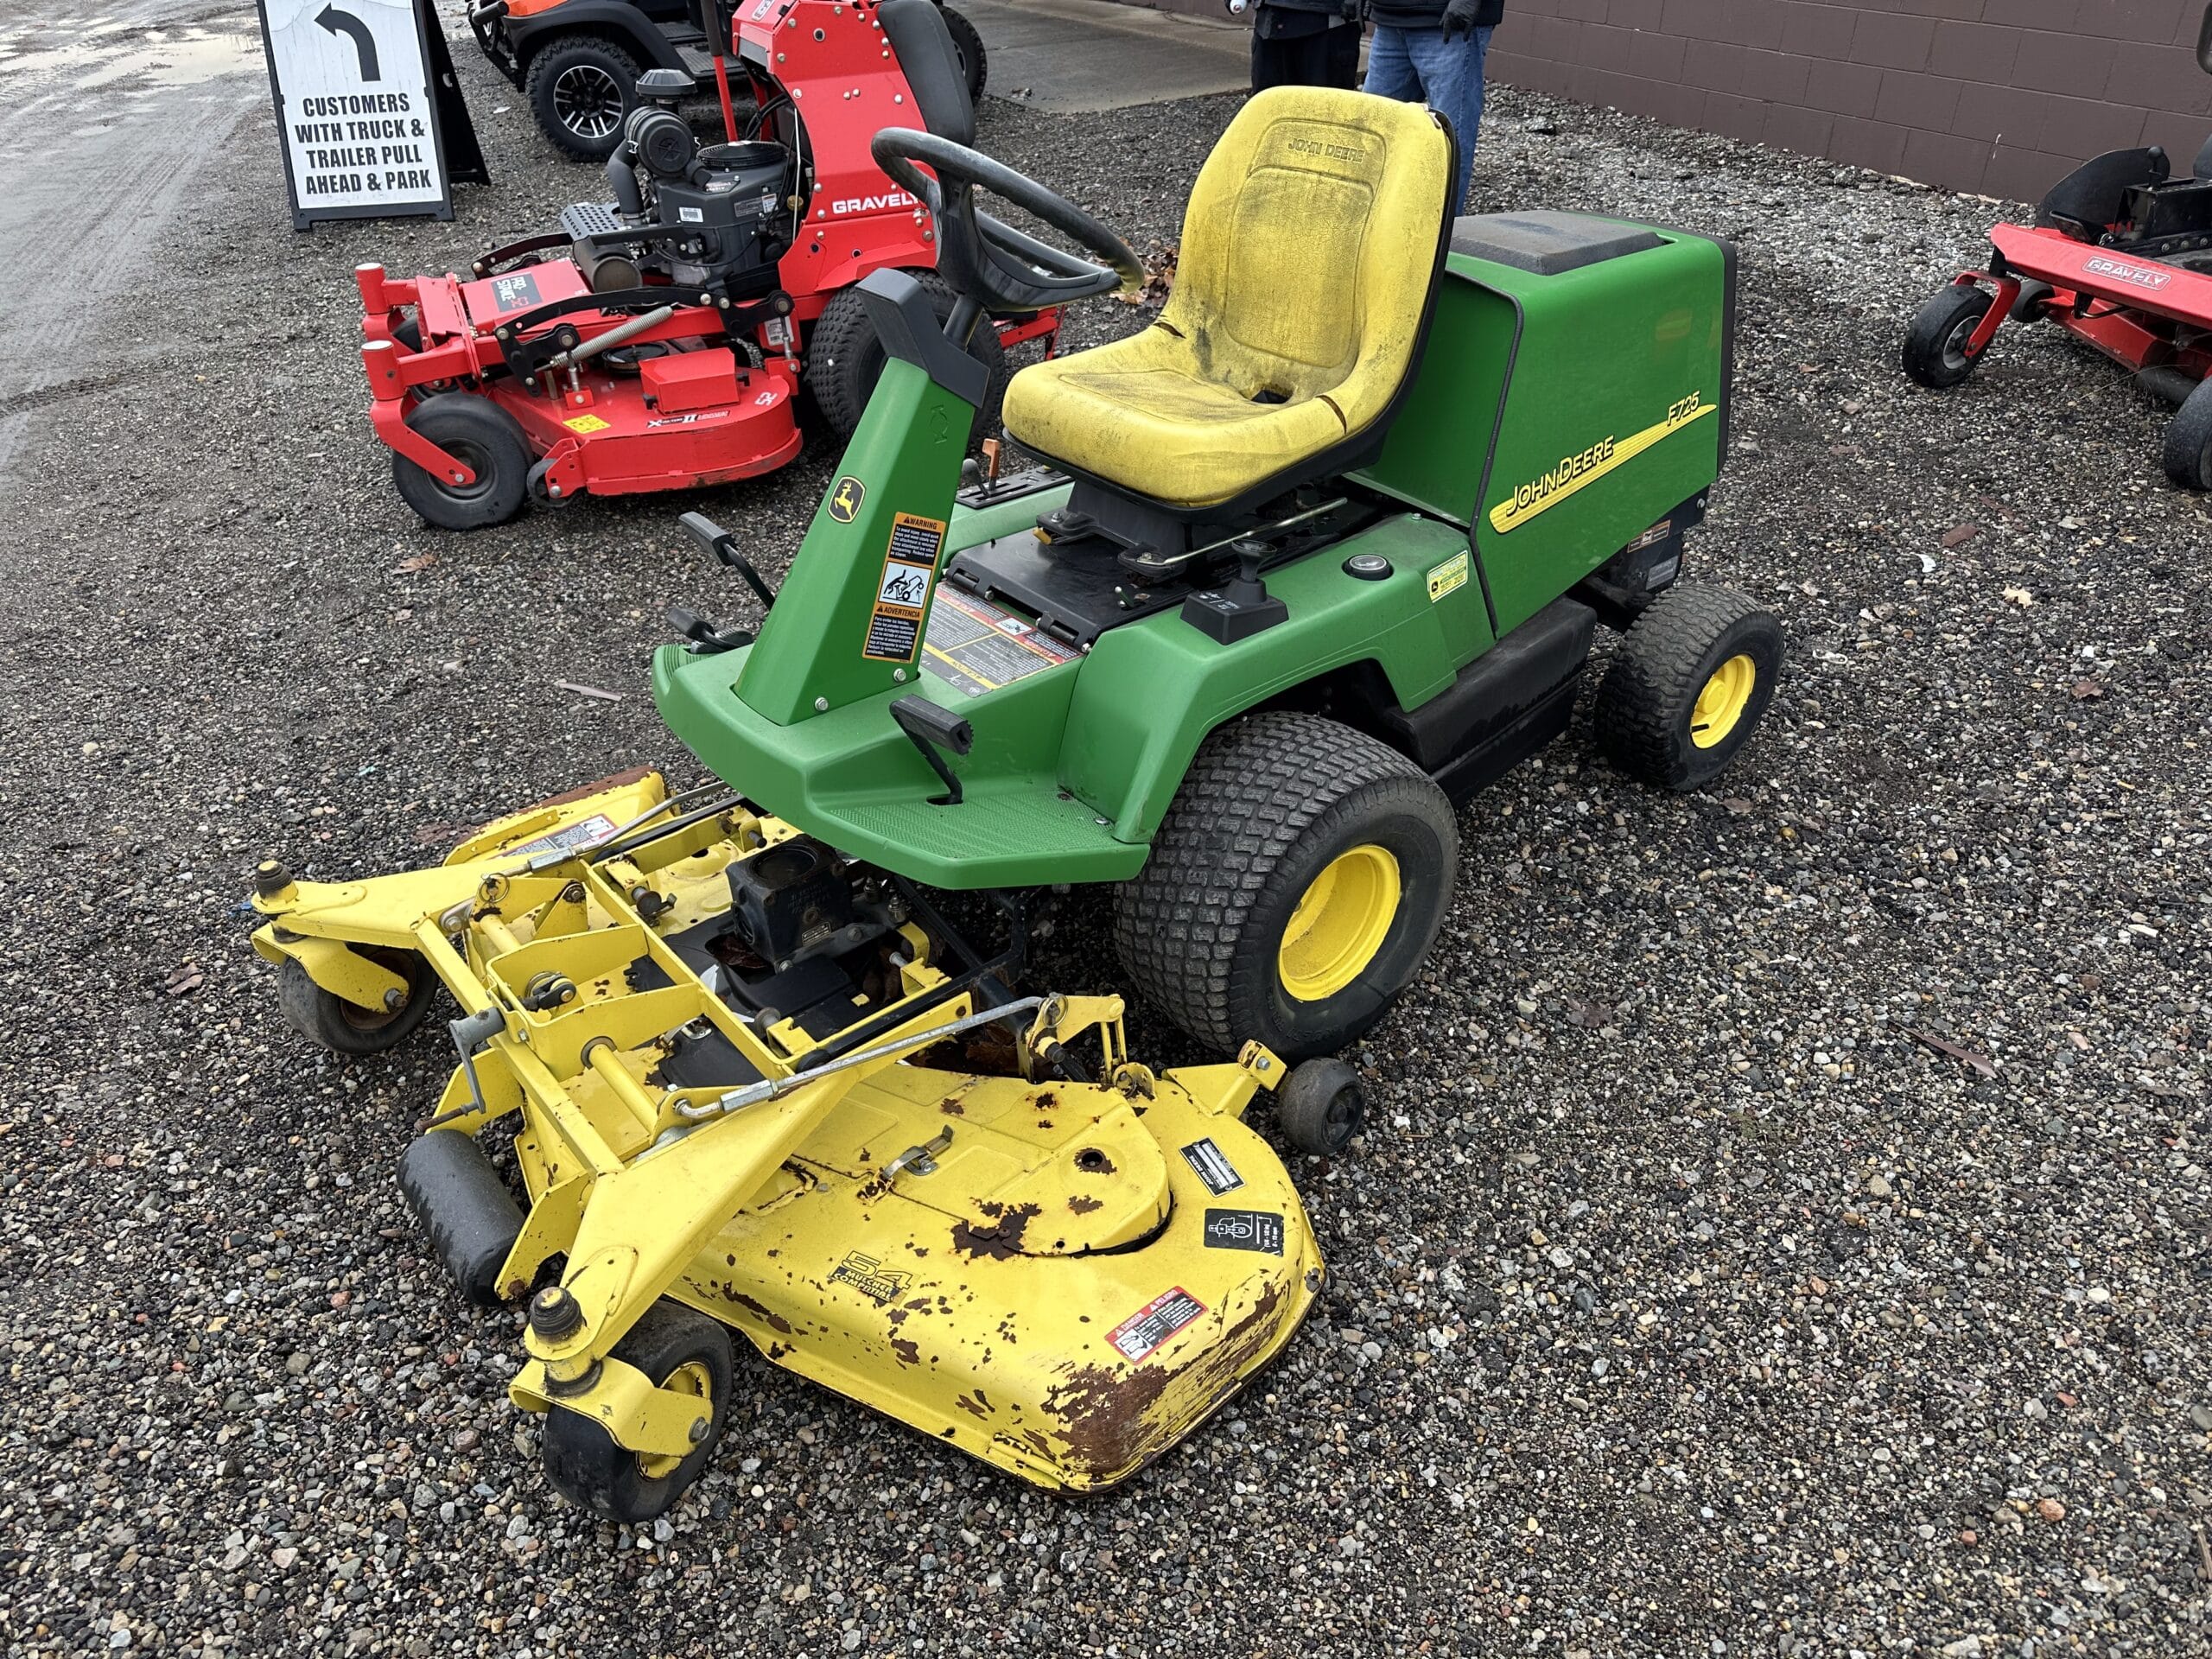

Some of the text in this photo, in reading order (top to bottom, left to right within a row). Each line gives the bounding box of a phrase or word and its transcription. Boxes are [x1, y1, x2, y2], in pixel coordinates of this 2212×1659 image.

[302, 92, 410, 117] CUSTOMERS
[295, 118, 425, 143] WITH TRUCK &
[306, 144, 423, 168] TRAILER PULL
[1287, 138, 1364, 162] JOHN DEERE
[306, 169, 432, 194] AHEAD & PARK
[2088, 259, 2167, 286] GRAVELY
[754, 391, 778, 405] 52
[1667, 391, 1700, 426] F725
[1506, 435, 1614, 517] JOHN DEERE
[910, 518, 938, 530] WARNING
[884, 607, 920, 617] ADVERTENCIA
[842, 1250, 913, 1290] 54
